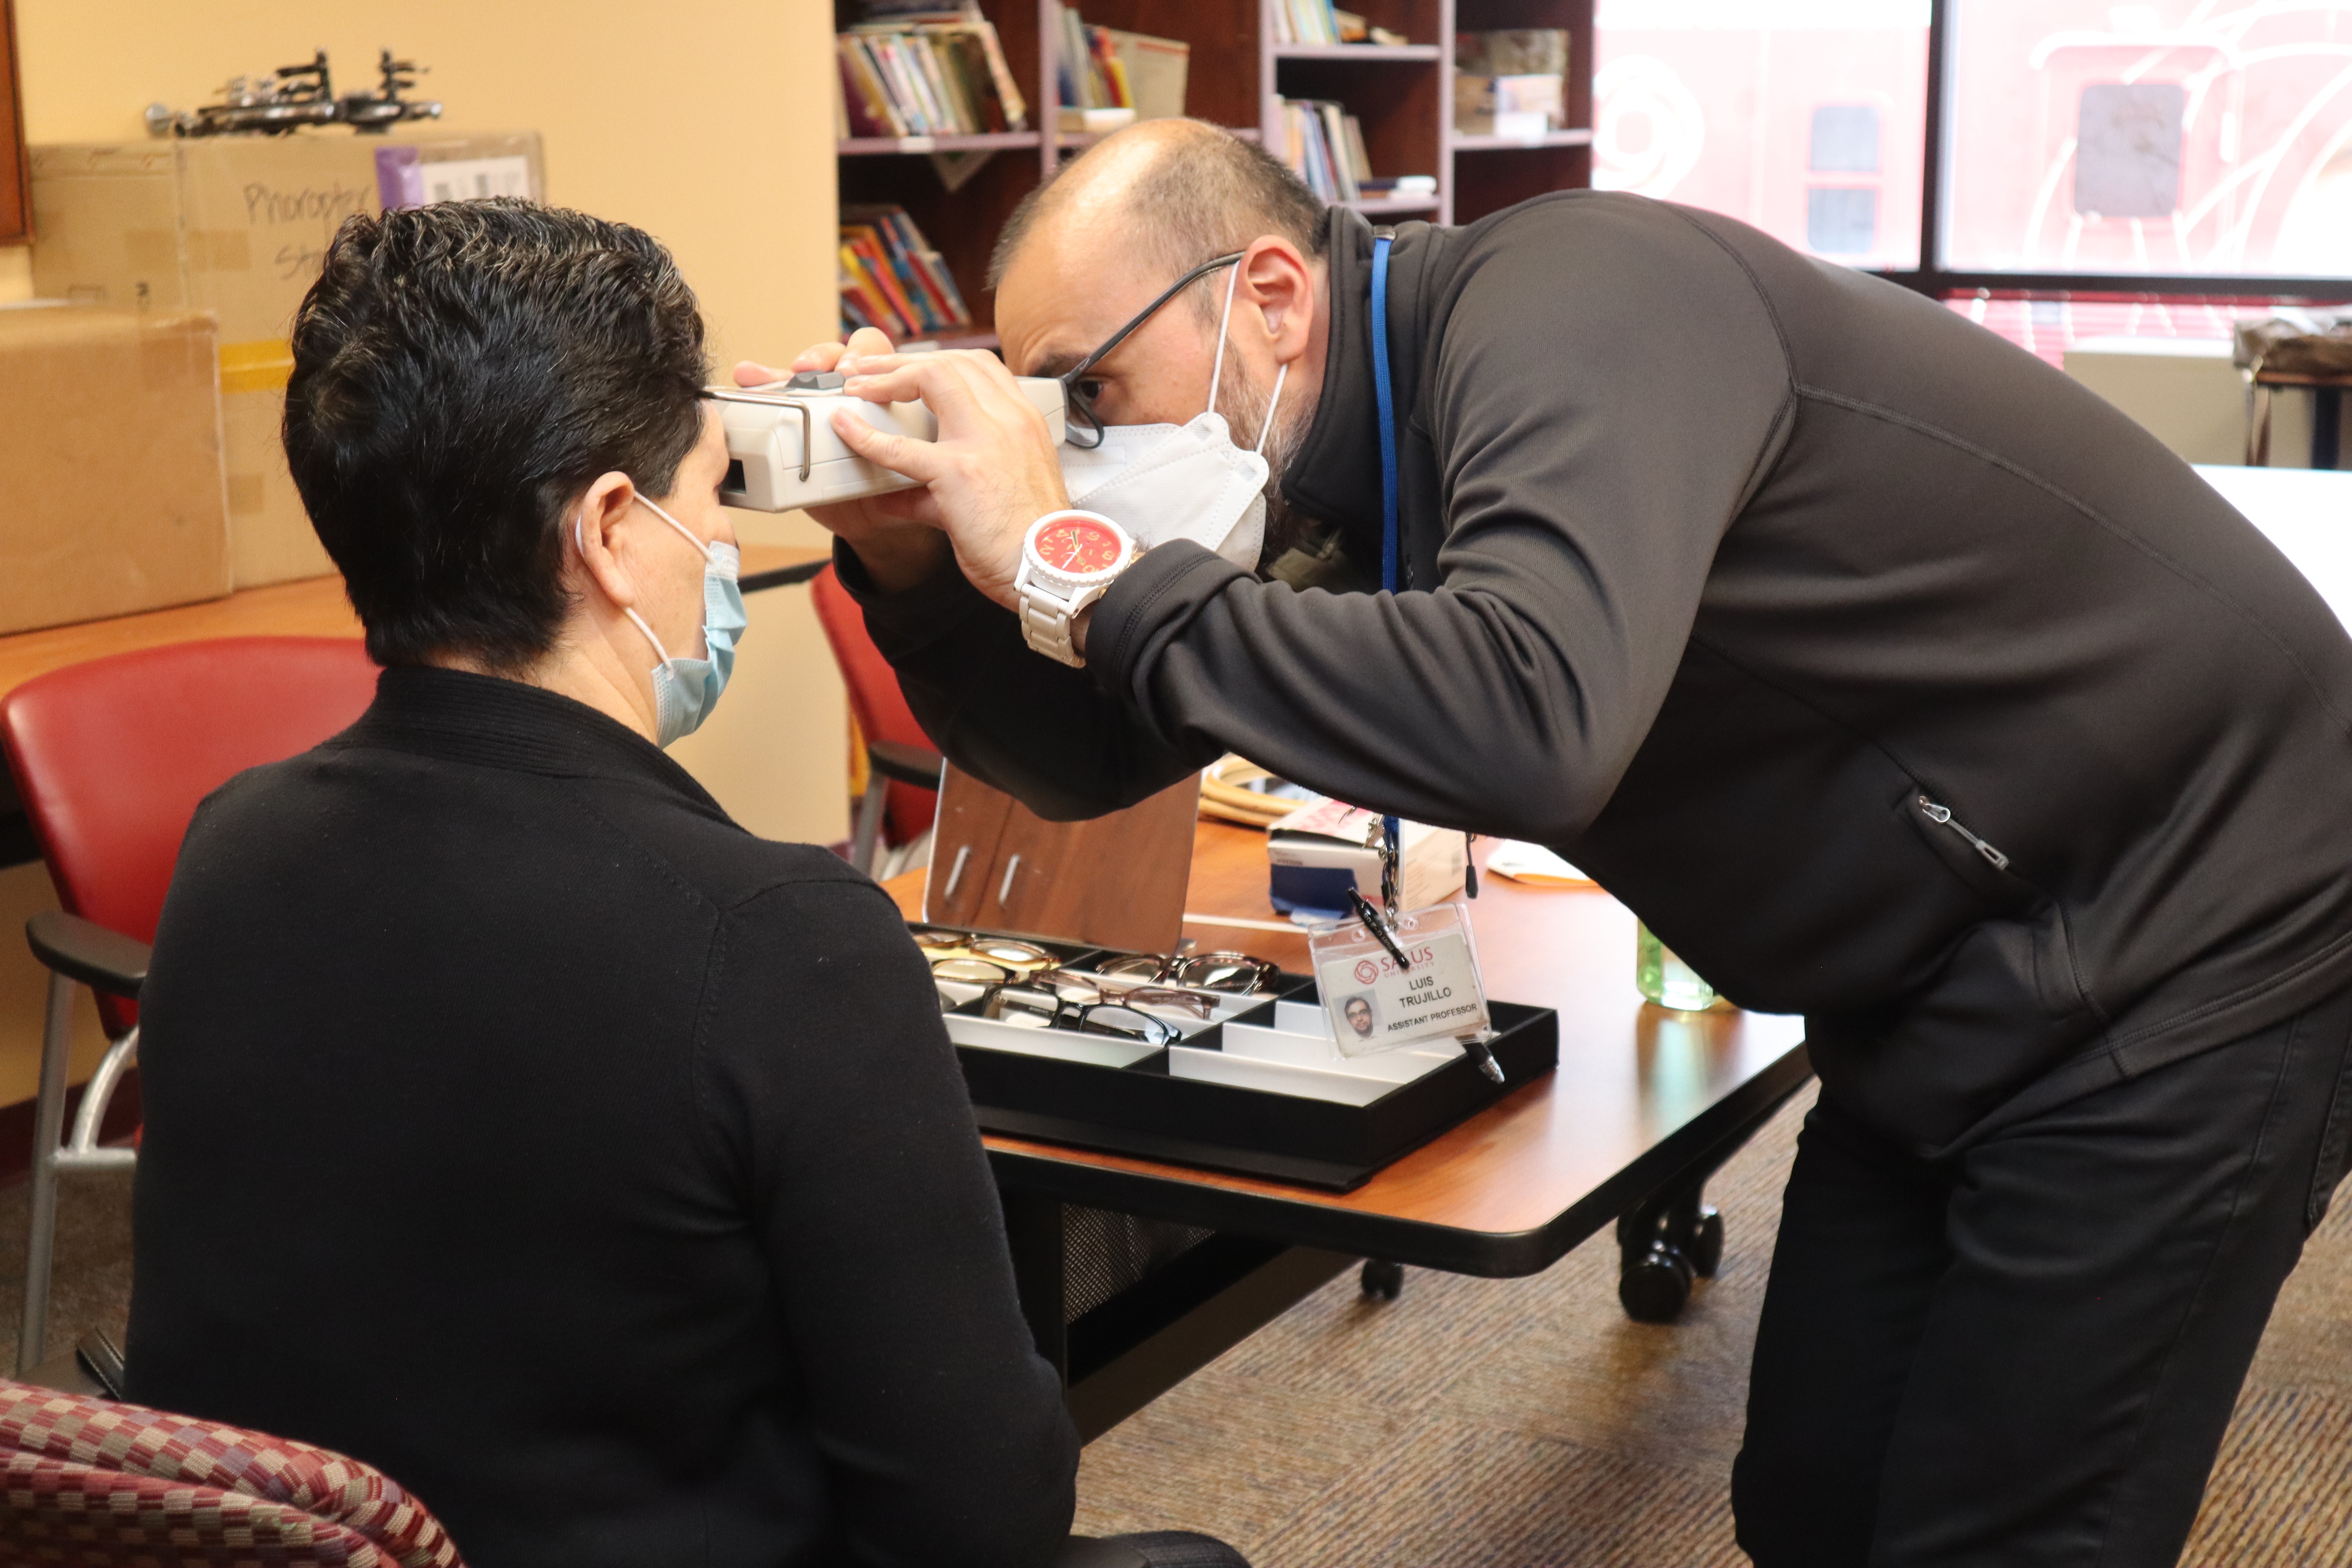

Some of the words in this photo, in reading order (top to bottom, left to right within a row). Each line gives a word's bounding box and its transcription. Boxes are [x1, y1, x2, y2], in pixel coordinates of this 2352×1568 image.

[1381, 947, 1433, 971] SAUS
[1409, 976, 1434, 991] LUIS
[1399, 987, 1452, 1008] TRUJILLO
[1388, 1016, 1428, 1032] ASSISTANT
[1431, 1004, 1477, 1021] PROFESSOR
